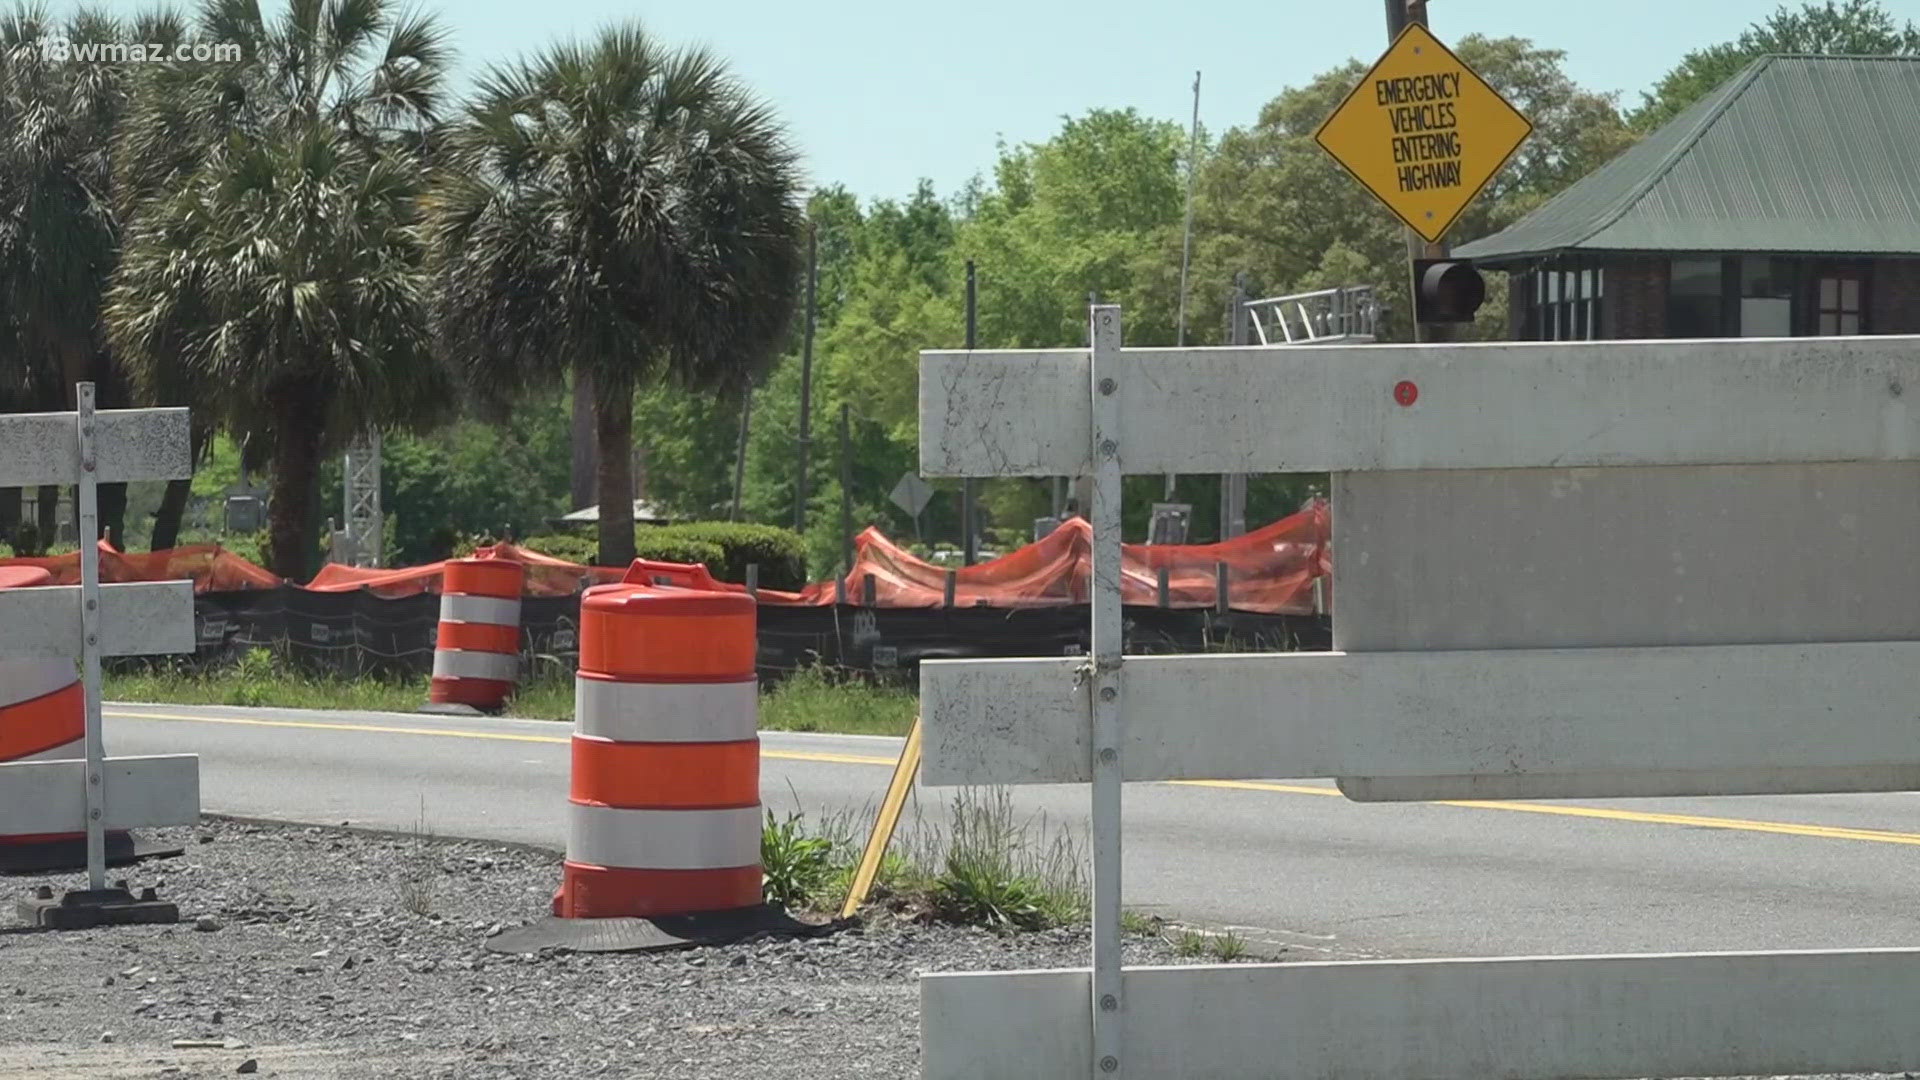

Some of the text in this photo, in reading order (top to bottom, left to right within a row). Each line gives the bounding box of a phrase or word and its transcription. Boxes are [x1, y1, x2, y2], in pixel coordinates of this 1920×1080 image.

[1375, 72, 1461, 106] EMERGENCY
[1389, 103, 1457, 133] VEHICLES
[1391, 132, 1461, 163] ENTERING
[1397, 160, 1461, 192] HIGHWAY
